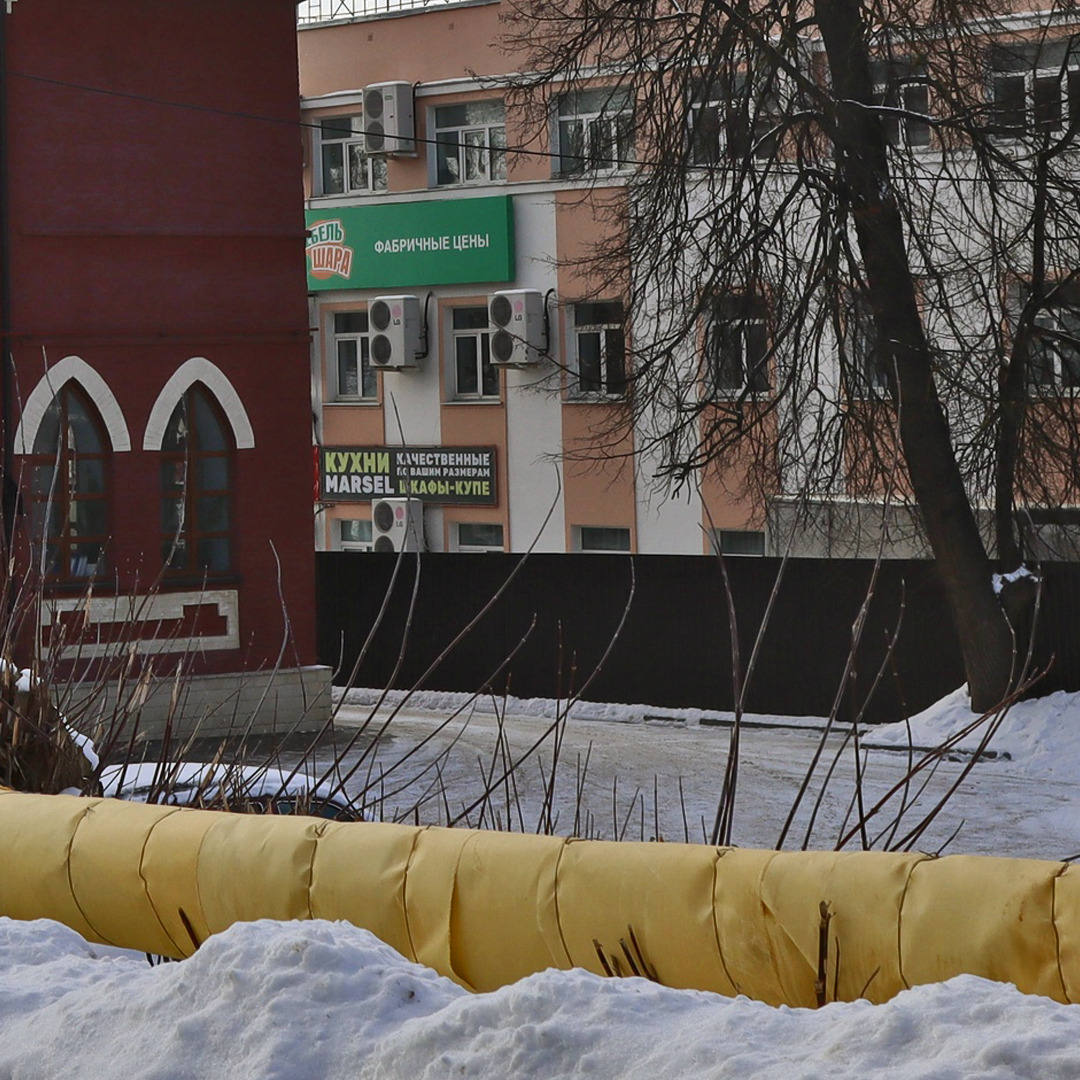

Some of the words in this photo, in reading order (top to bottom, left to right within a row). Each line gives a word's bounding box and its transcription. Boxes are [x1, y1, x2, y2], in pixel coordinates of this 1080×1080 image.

[306, 222, 343, 246] БЕЛЬ
[374, 236, 450, 254] ФАБРИЧНЫЕ
[453, 234, 490, 251] ЦЕНЫ
[312, 246, 352, 276] ШАРА
[325, 452, 390, 473] КУХНИ
[396, 453, 490, 466] КАЧЕСТВЕННЫЕ
[410, 467, 441, 476] ВАШИМ
[443, 467, 490, 477] РАЗМЕРАМ
[325, 475, 394, 494] MARSEL
